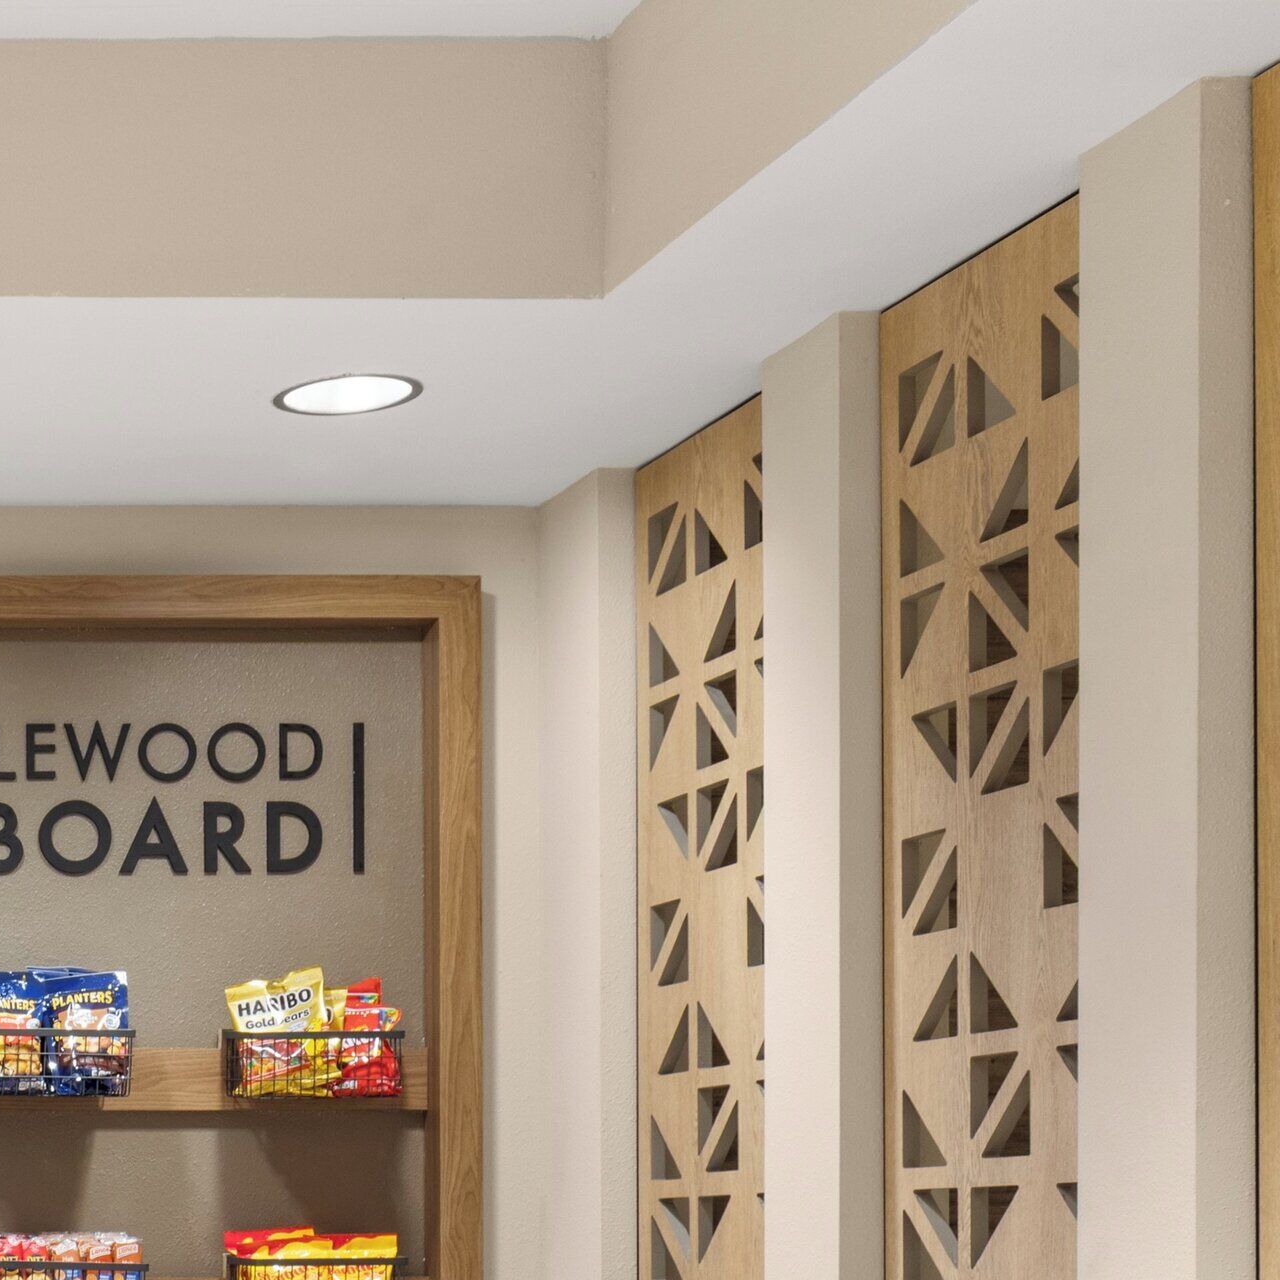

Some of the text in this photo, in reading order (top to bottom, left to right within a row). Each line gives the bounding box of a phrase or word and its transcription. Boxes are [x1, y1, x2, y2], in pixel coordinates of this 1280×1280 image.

[51, 990, 113, 1011] PLANTERS
[238, 988, 313, 1018] HARIBO
[245, 1008, 310, 1030] Goldears
